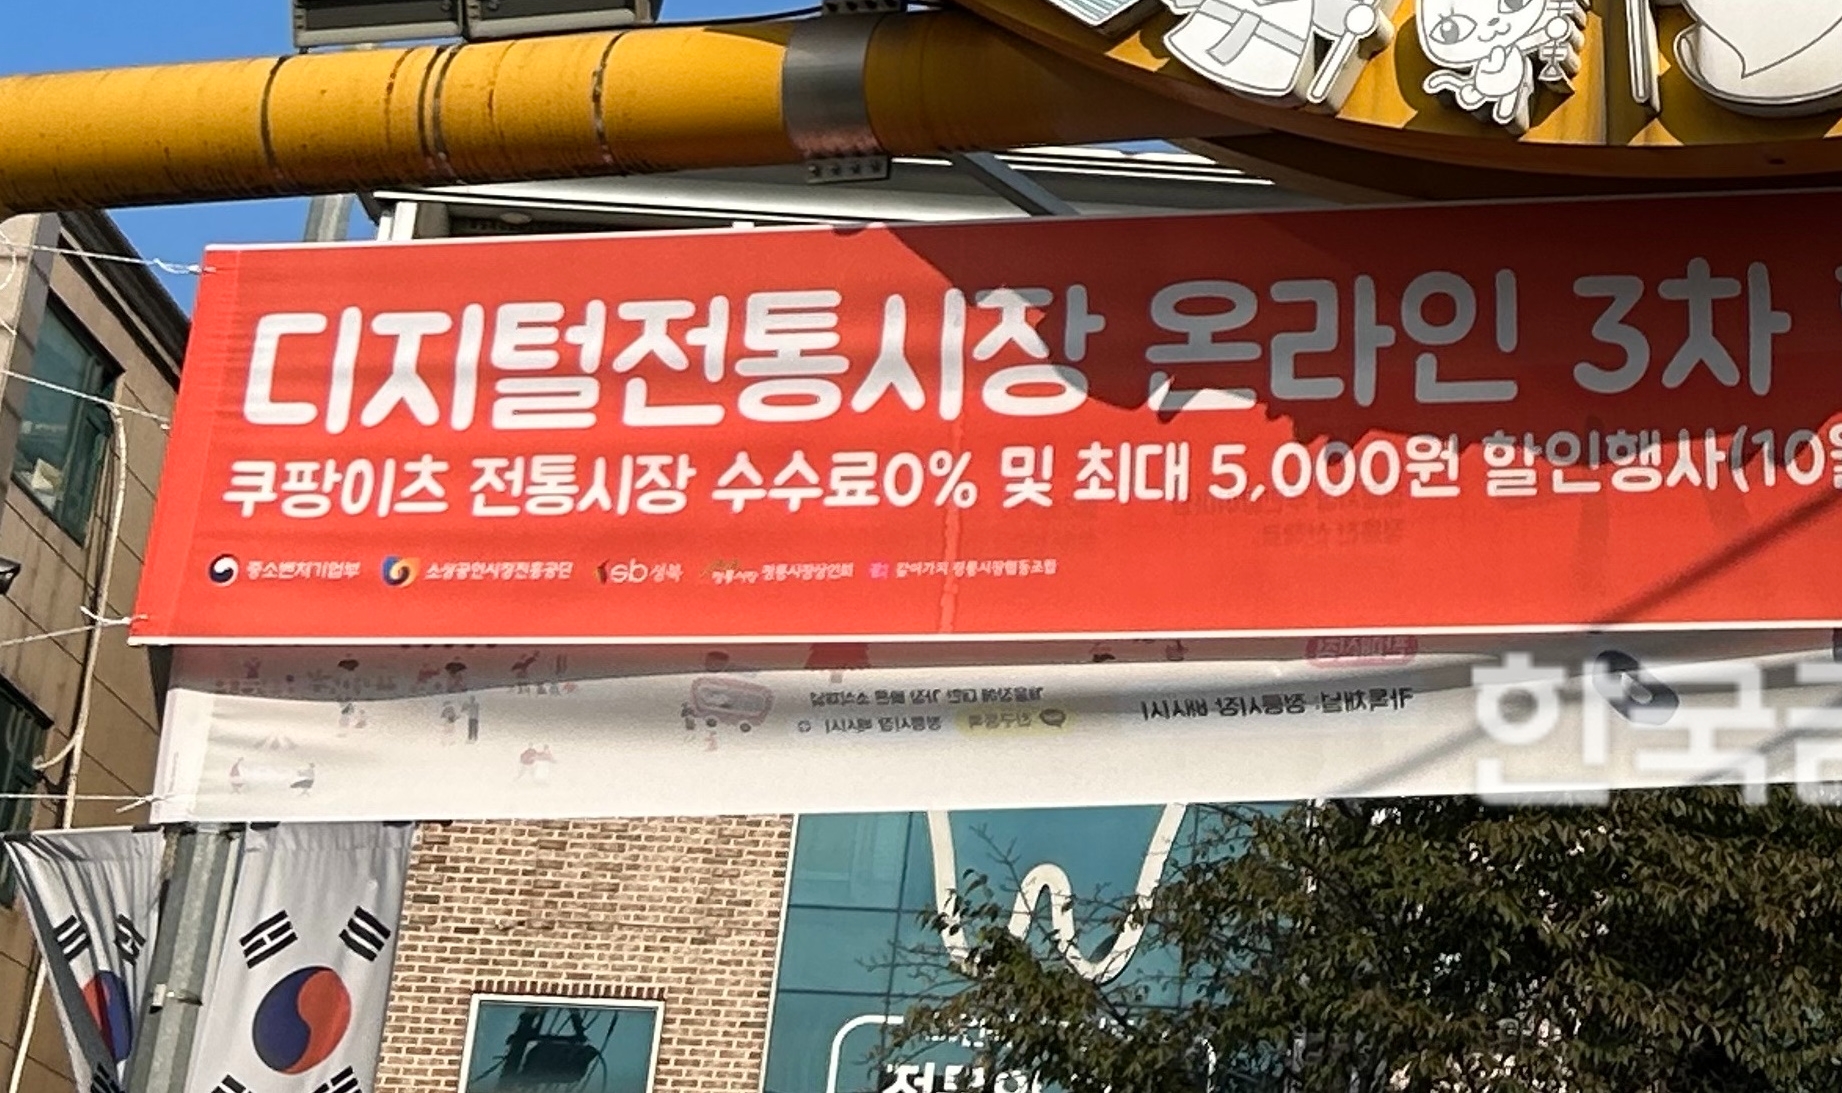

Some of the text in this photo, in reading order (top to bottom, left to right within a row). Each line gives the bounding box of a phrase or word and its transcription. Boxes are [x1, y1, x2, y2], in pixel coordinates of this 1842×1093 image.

[242, 282, 1105, 434] 디지털전통시장
[1145, 268, 1519, 411] 온라인
[1573, 256, 1792, 396] 3차
[222, 453, 450, 518] 쿠팡이츠
[470, 452, 696, 518] 전통시장
[710, 448, 980, 514] 수수료0%
[1001, 443, 1054, 510] 및
[1073, 439, 1191, 504] 최대
[1209, 431, 1462, 504] 5,000원
[610, 558, 649, 583] sb
